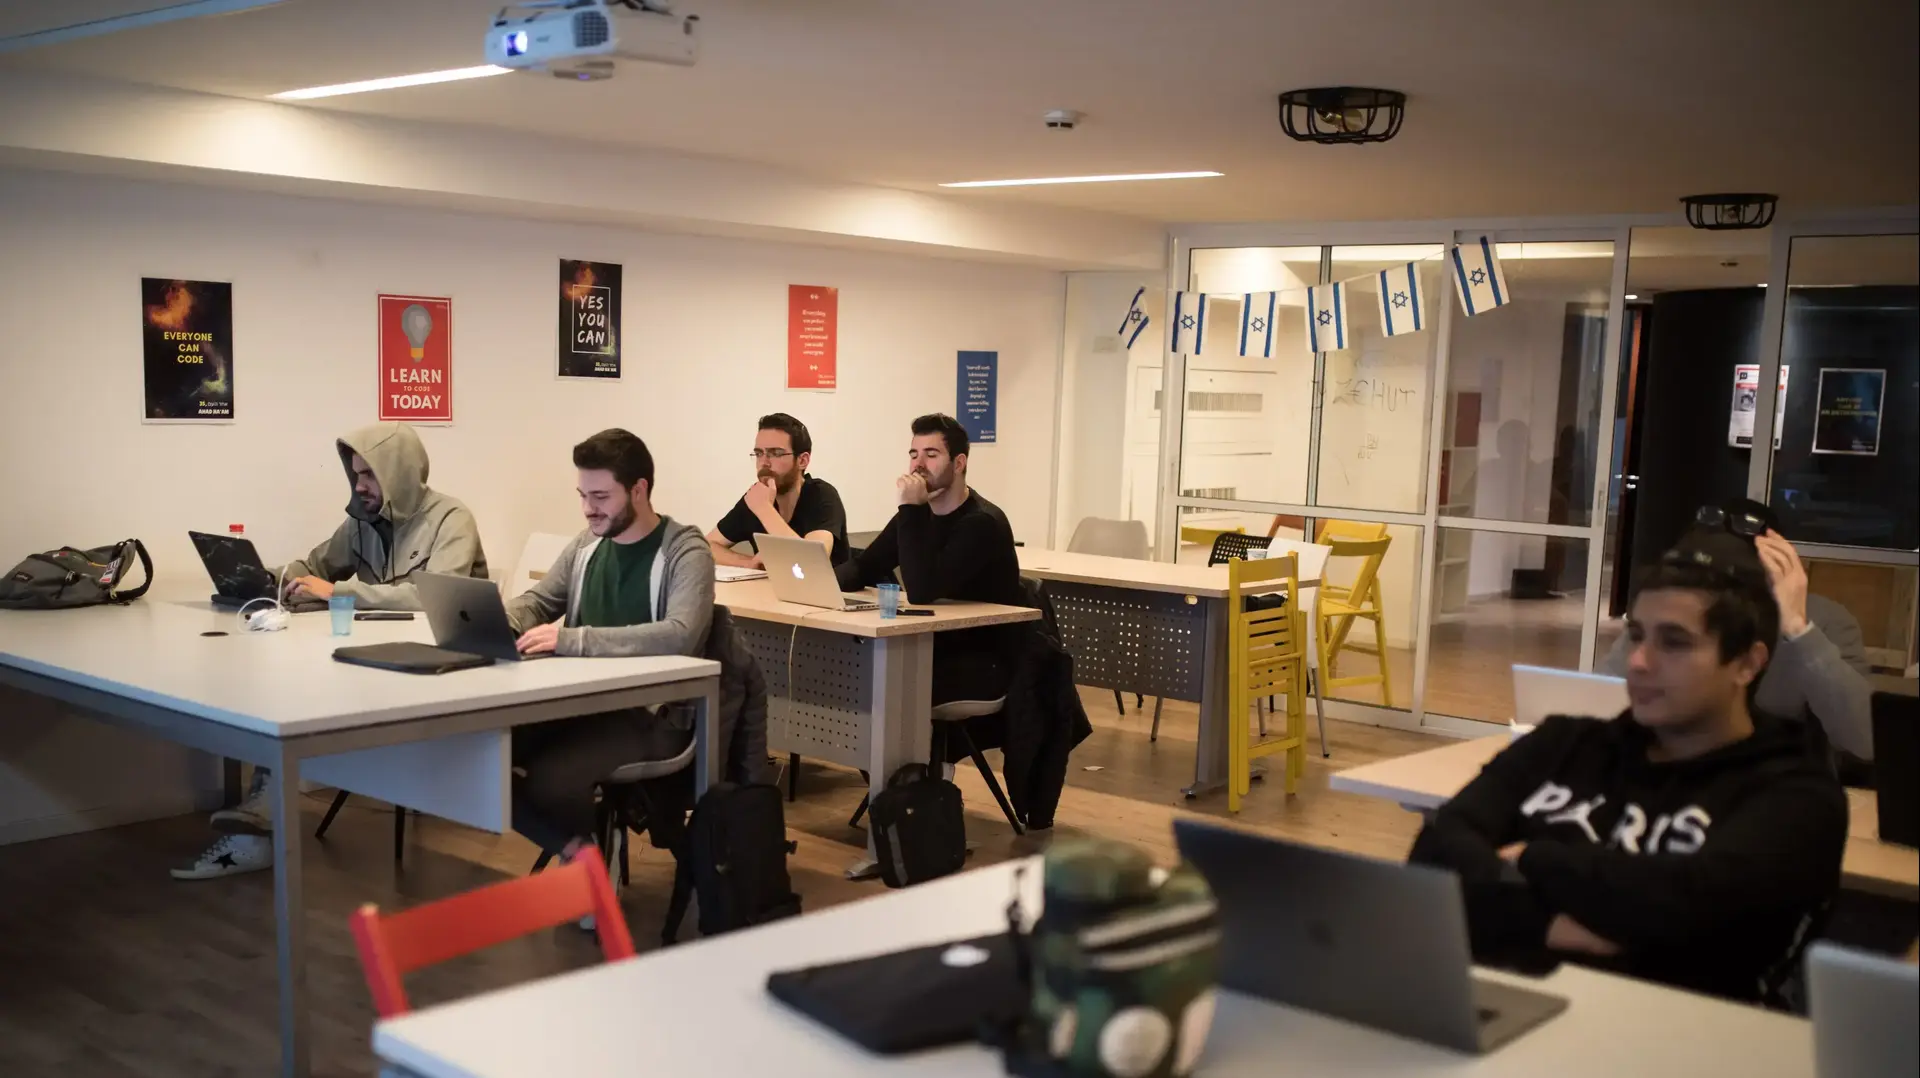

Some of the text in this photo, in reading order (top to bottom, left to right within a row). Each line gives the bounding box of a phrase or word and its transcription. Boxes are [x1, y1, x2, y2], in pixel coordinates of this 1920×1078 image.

[580, 296, 604, 310] YES
[579, 313, 605, 328] YOU
[164, 332, 213, 341] EVERYONE
[577, 330, 605, 346] CAN
[178, 344, 200, 352] CAN
[177, 355, 204, 364] CODE
[390, 368, 442, 383] LEARN
[391, 395, 441, 409] TODAY
